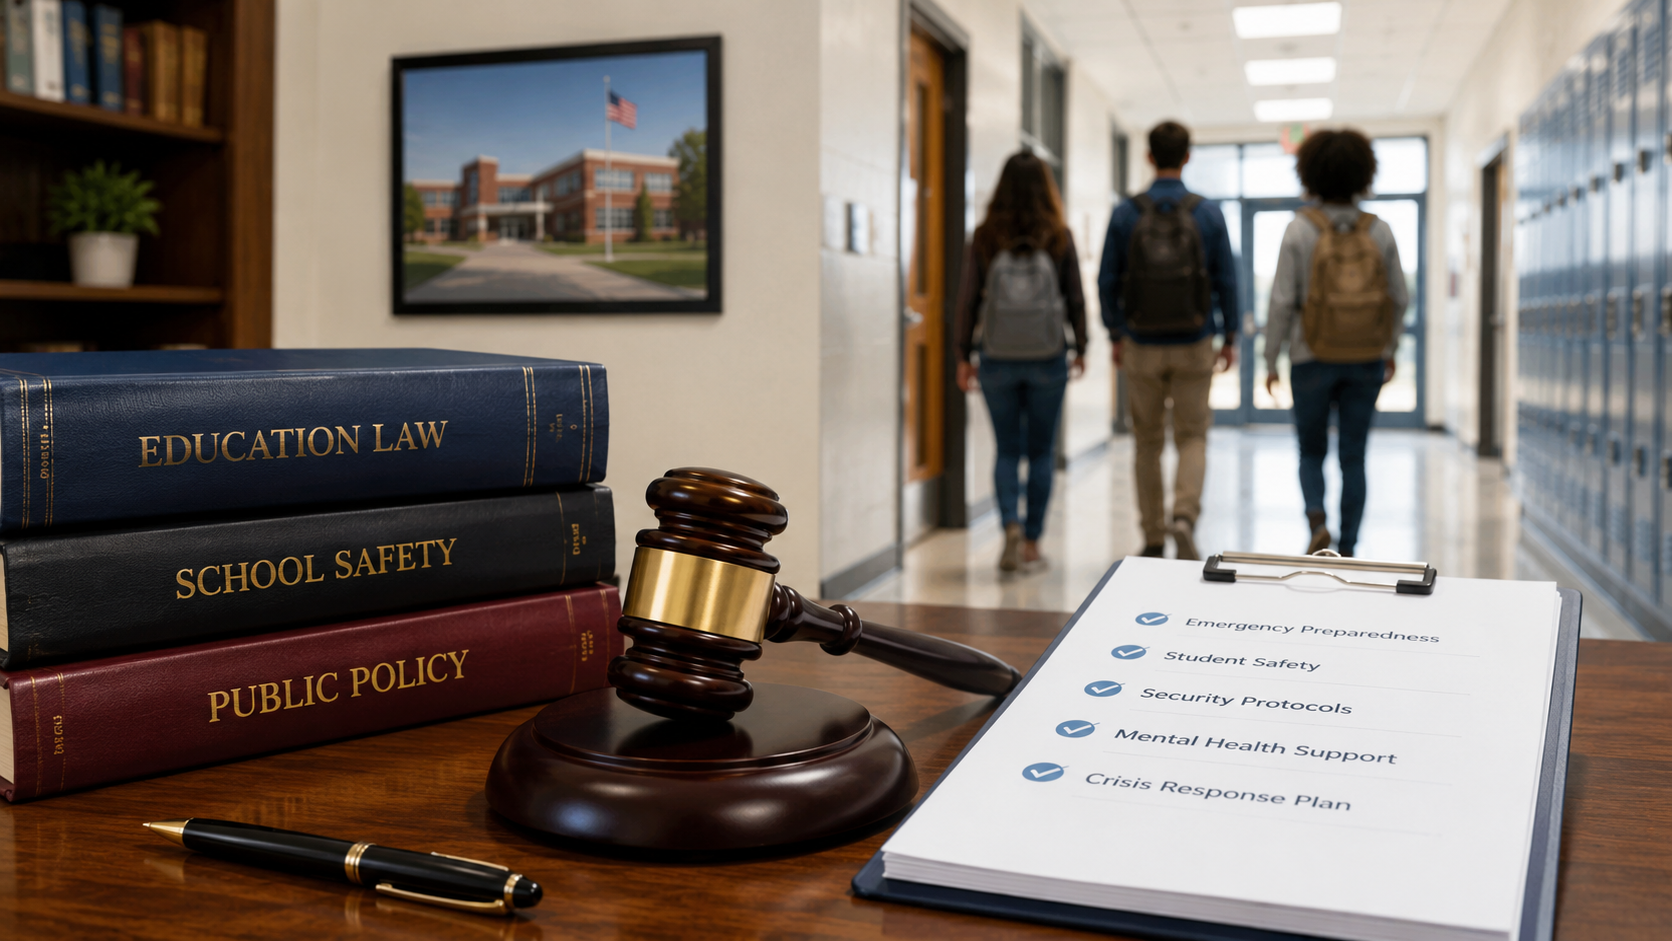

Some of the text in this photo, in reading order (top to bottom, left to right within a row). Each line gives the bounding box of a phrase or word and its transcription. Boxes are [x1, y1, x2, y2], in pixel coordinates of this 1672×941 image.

[139, 420, 448, 467] EDUCATION LAW
[175, 537, 457, 600] SCHOOL SAFETY
[1186, 617, 1440, 643] Emergency Preparedness
[1163, 651, 1321, 673] Student Safety
[207, 649, 470, 723] PUBLIC POLICY
[1140, 688, 1353, 715] Security Protocols
[1114, 728, 1398, 765] Mental Health Support
[1085, 772, 1352, 811] Crisis Response Plan
